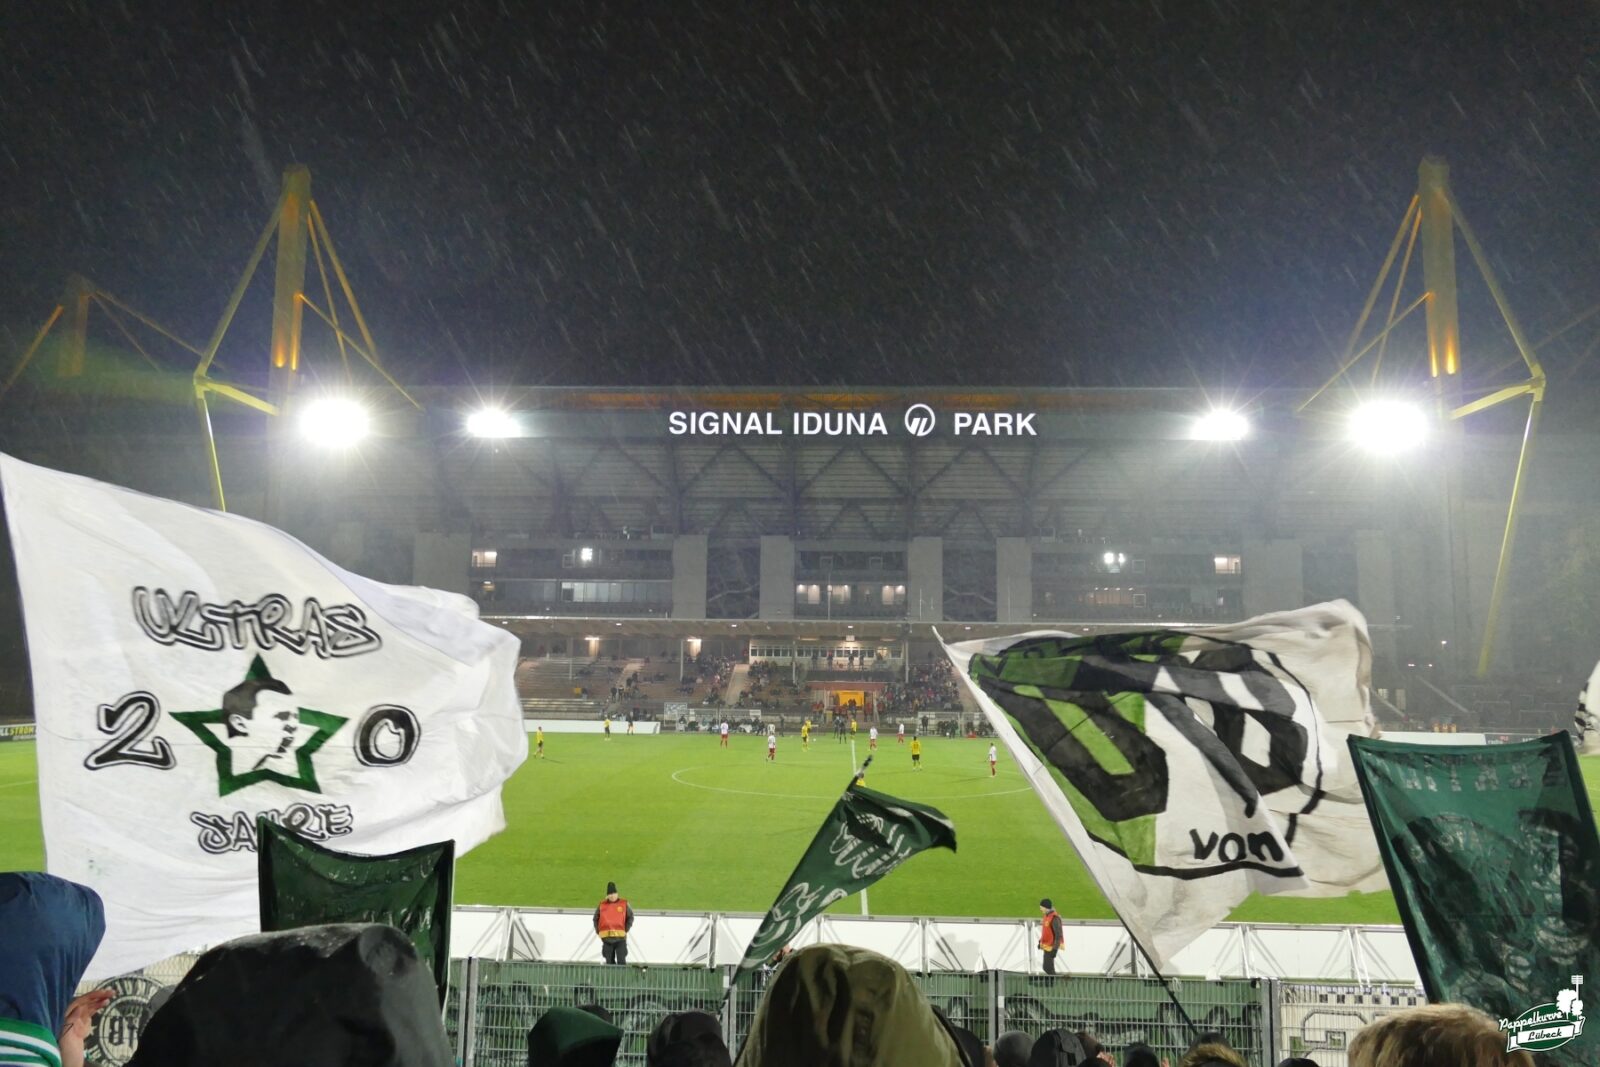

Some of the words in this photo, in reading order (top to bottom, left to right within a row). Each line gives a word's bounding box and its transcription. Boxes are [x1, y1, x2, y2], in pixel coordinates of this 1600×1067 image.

[668, 411, 783, 435] SIGNAL
[793, 412, 888, 435] IDUNA
[954, 412, 1037, 436] PARK
[132, 585, 382, 659] ULTRAS
[84, 690, 176, 771] 2
[189, 803, 353, 855] JARE
[1189, 828, 1285, 864] von
